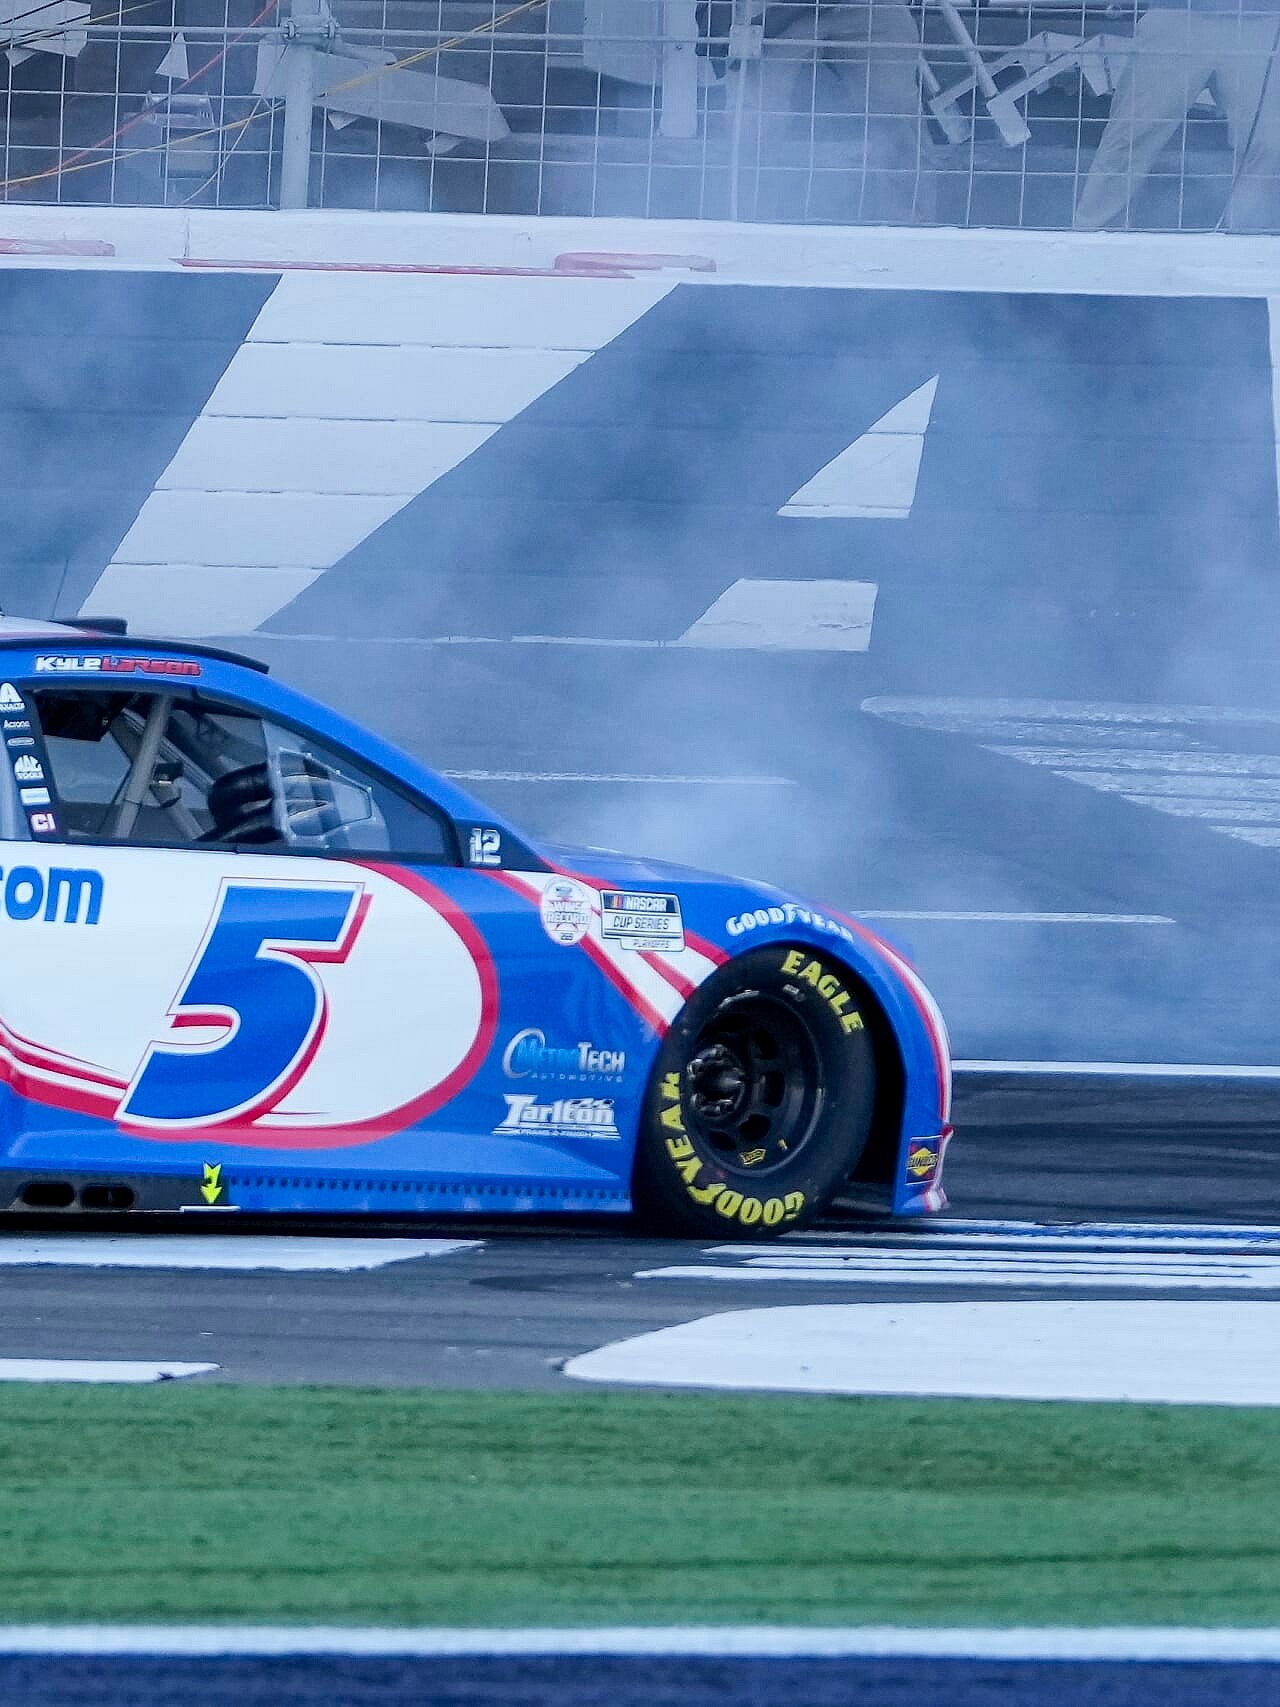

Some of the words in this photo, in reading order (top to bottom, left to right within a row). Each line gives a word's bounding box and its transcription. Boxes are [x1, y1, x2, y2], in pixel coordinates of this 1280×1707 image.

[470, 828, 502, 864] 12
[613, 915, 633, 928] CUP
[634, 917, 670, 930] SERIES
[625, 896, 668, 912] NASCAR
[114, 877, 374, 1135] 5
[781, 950, 864, 1034] EAGLE
[660, 1071, 807, 1225] GOODYEAR
